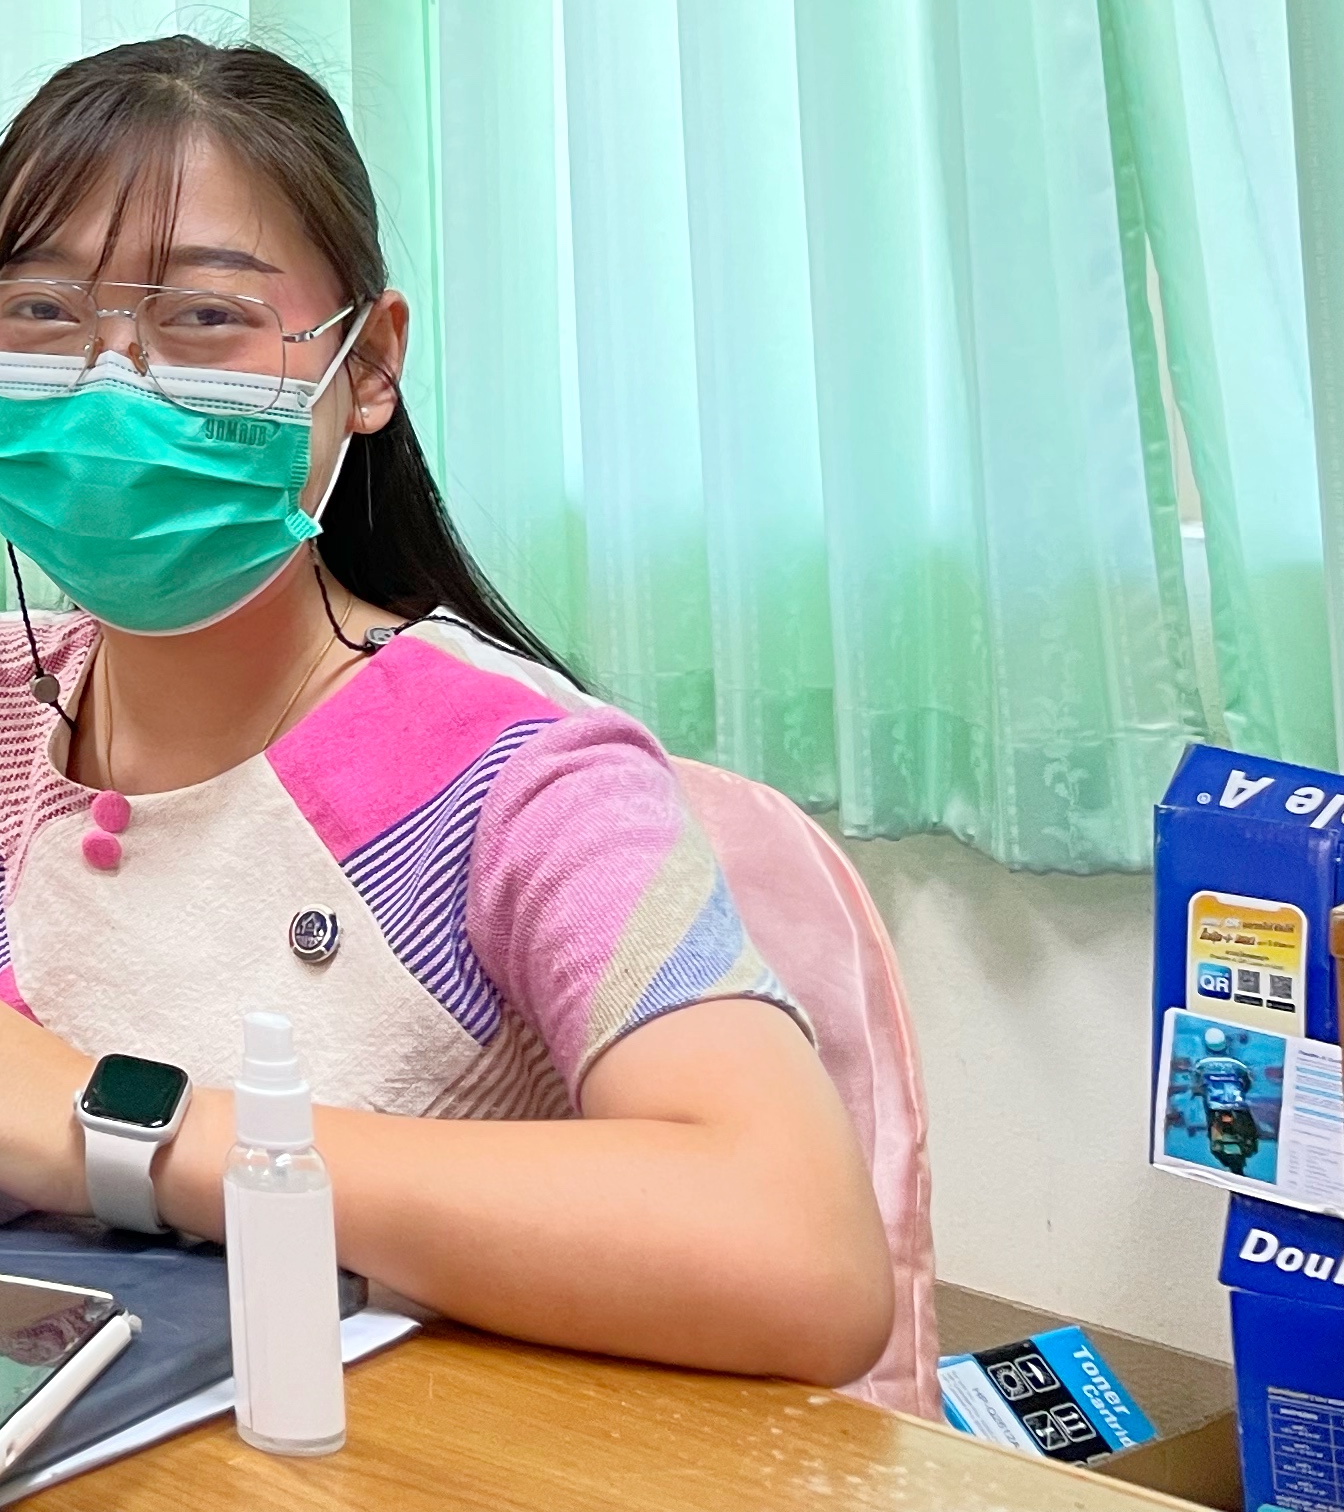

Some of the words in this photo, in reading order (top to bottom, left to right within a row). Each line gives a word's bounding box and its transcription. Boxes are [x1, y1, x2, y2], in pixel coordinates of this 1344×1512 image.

[1218, 769, 1275, 809] A
[1199, 974, 1231, 992] QR
[1072, 1344, 1131, 1416] Toner
